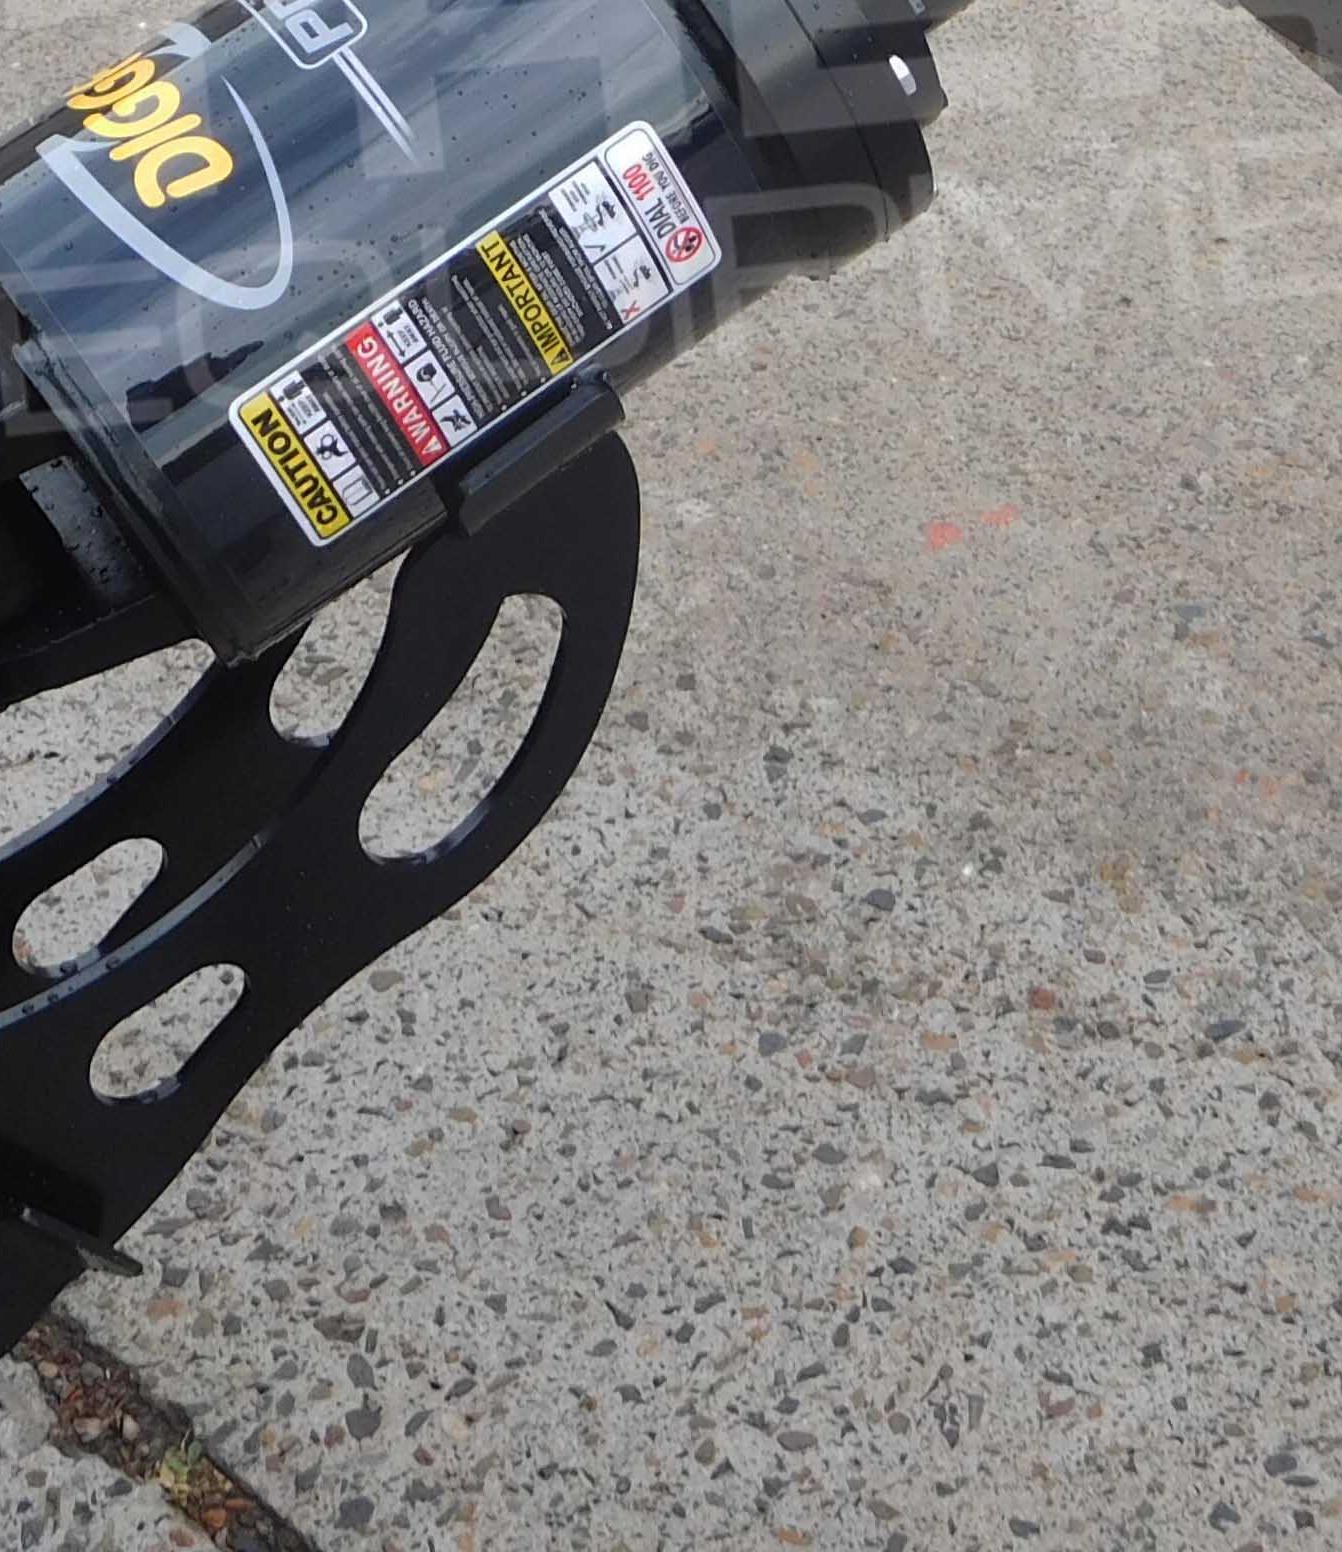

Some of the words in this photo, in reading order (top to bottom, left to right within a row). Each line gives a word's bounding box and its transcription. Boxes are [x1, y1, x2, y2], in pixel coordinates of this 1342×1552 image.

[63, 51, 233, 209] DIGG
[622, 163, 655, 201] 1100
[645, 197, 676, 239] DIAL
[665, 190, 690, 224] BEFORE
[408, 298, 436, 338] HAZARD
[481, 241, 561, 353] IMPORTANT
[357, 336, 431, 444] WARNING
[251, 407, 338, 525] CAUTION
